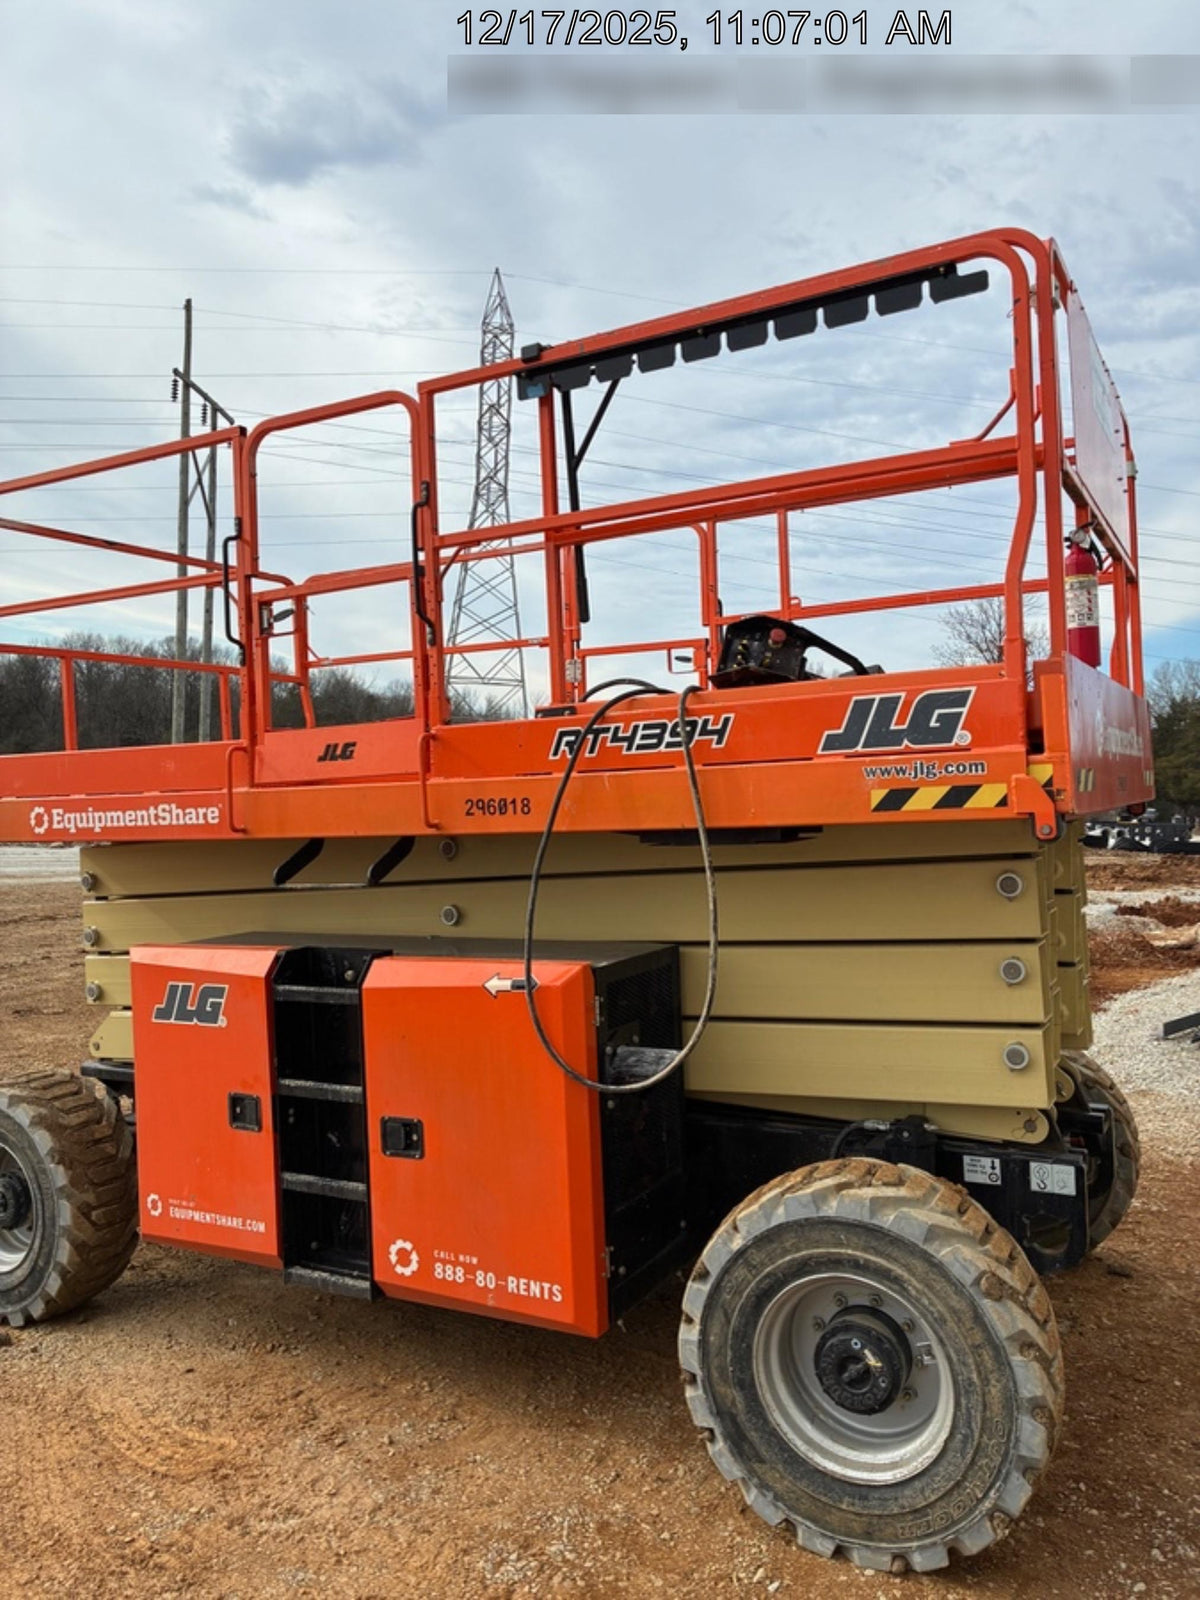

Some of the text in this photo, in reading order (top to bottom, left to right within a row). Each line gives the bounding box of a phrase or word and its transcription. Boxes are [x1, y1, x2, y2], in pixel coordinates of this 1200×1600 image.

[817, 685, 977, 755] JLG
[548, 713, 736, 760] RT4394
[316, 740, 358, 763] JLG
[863, 760, 988, 781] www.jlg.com
[51, 803, 220, 834] EquipmentShare
[464, 797, 532, 817] 296018
[152, 981, 230, 1028] JLG
[168, 1206, 266, 1234] EQUIPMENTSHARE.COM
[433, 1249, 456, 1262] CALL
[434, 1262, 563, 1303] 888-80-RENTS
